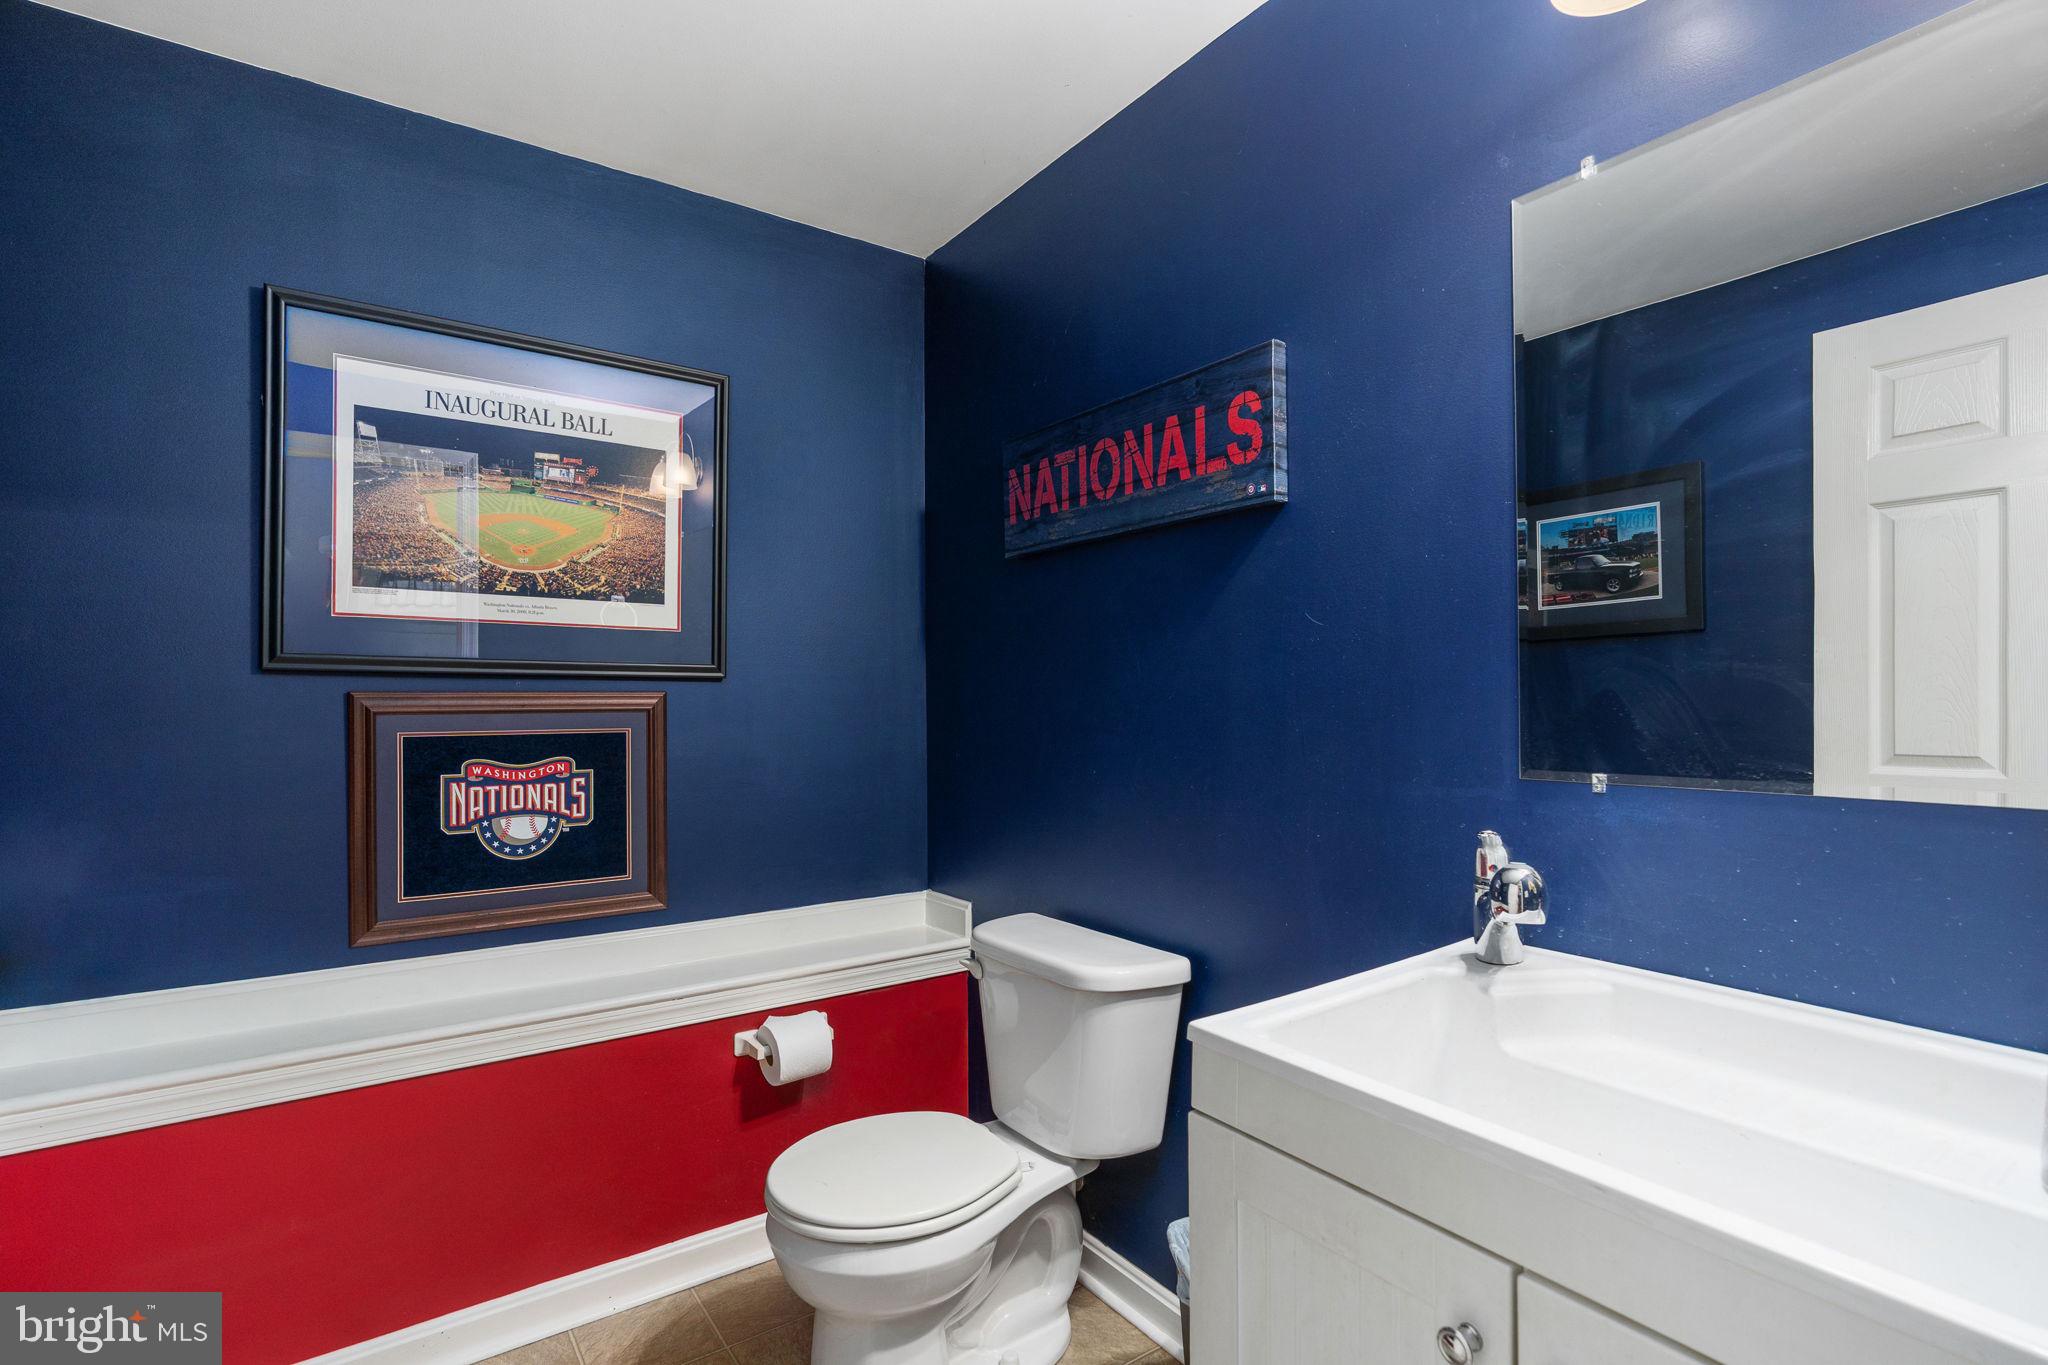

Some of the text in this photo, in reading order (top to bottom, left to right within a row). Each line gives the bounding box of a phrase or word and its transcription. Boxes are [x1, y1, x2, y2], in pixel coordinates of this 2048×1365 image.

[425, 390, 555, 428] INAUGURAL
[561, 411, 613, 436] BALL
[1008, 390, 1263, 525] NATIONALS
[472, 763, 565, 780] WASHINGTON
[449, 777, 586, 827] NATIONALS
